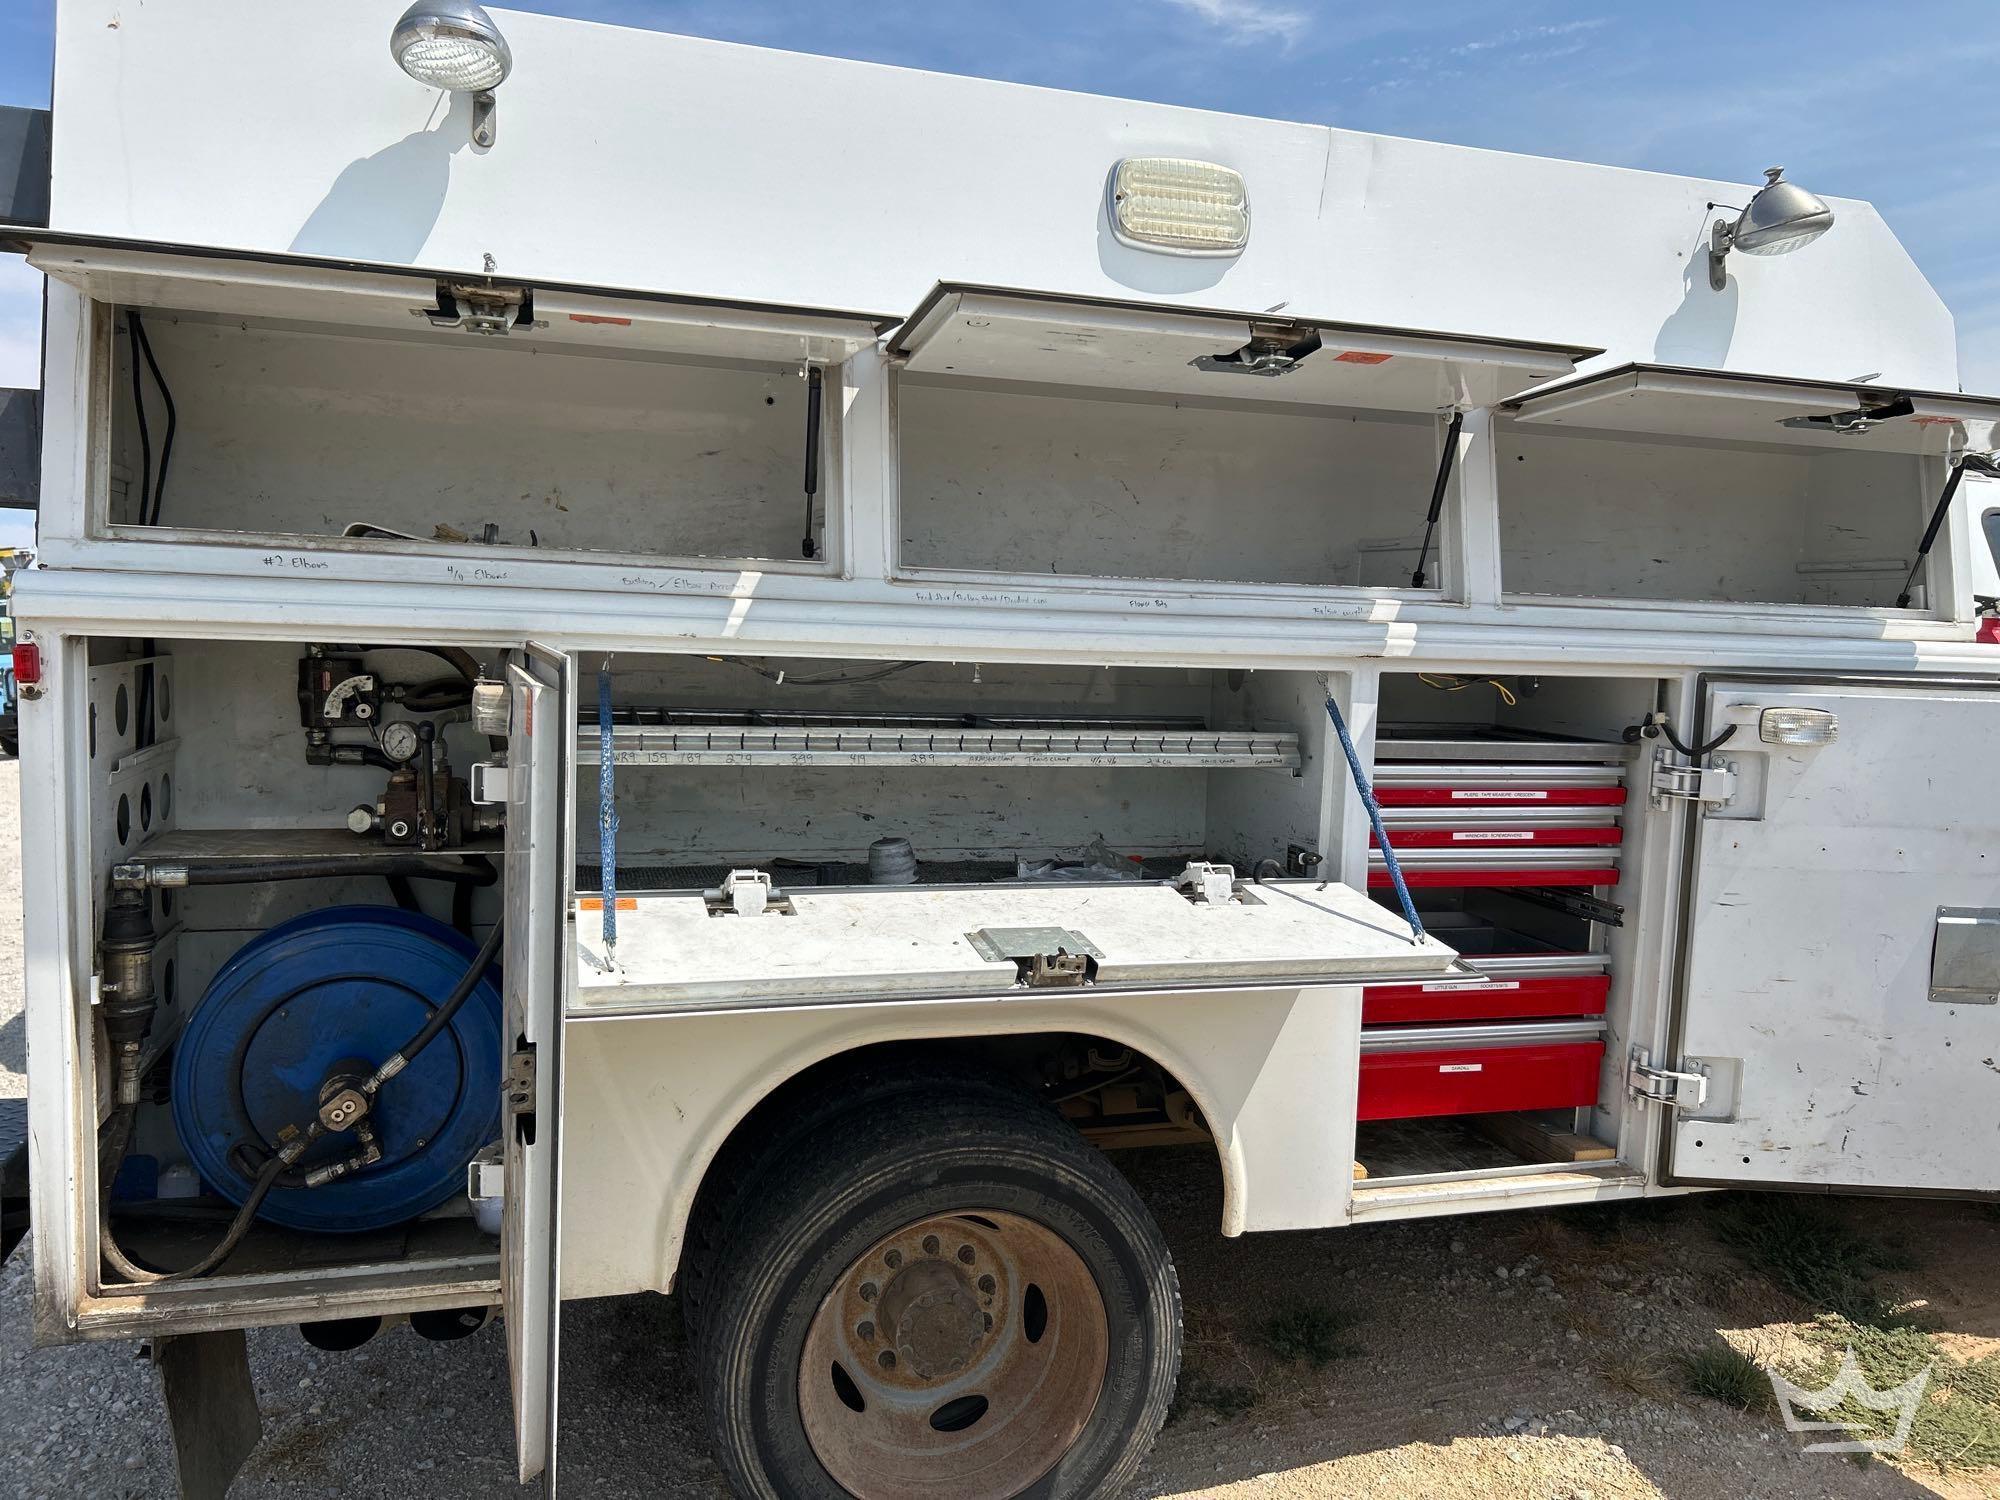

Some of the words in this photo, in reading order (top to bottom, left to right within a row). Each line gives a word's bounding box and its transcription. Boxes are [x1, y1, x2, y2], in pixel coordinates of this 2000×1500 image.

[292, 557, 329, 569] Elbows
[648, 752, 668, 764] 159
[681, 752, 701, 764] 189
[726, 753, 752, 765] 279
[910, 753, 935, 764] 289
